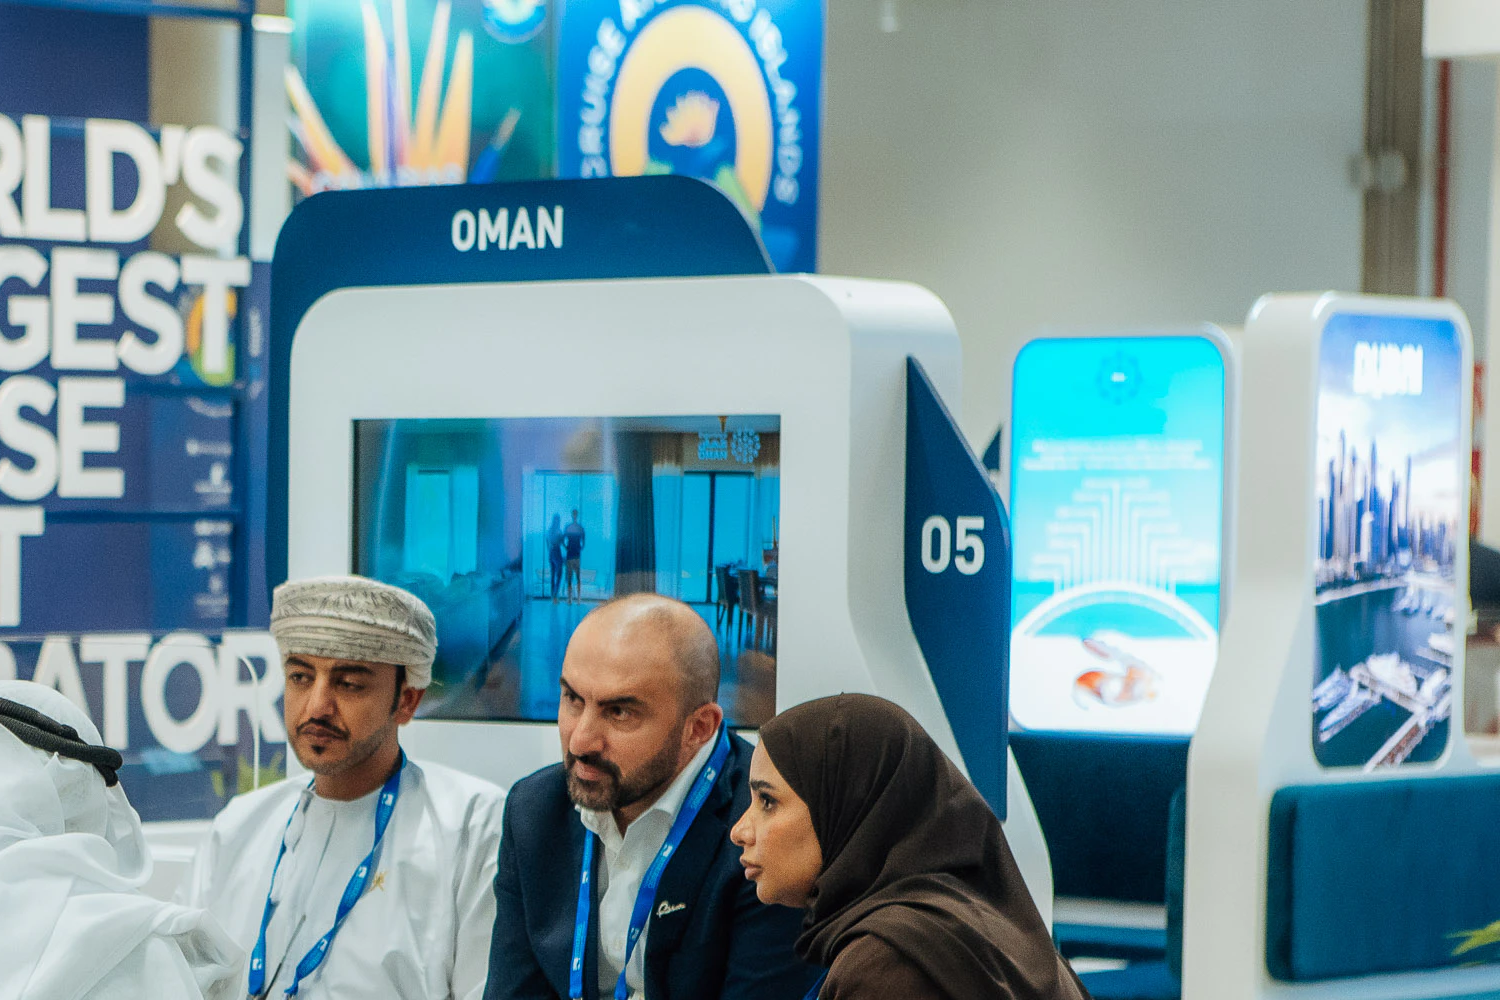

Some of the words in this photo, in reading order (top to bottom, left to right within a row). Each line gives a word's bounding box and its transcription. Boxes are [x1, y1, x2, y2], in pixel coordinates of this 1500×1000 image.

[749, 8, 803, 205] ISLANDS
[451, 205, 564, 252] OMAN
[921, 514, 985, 576] 05
